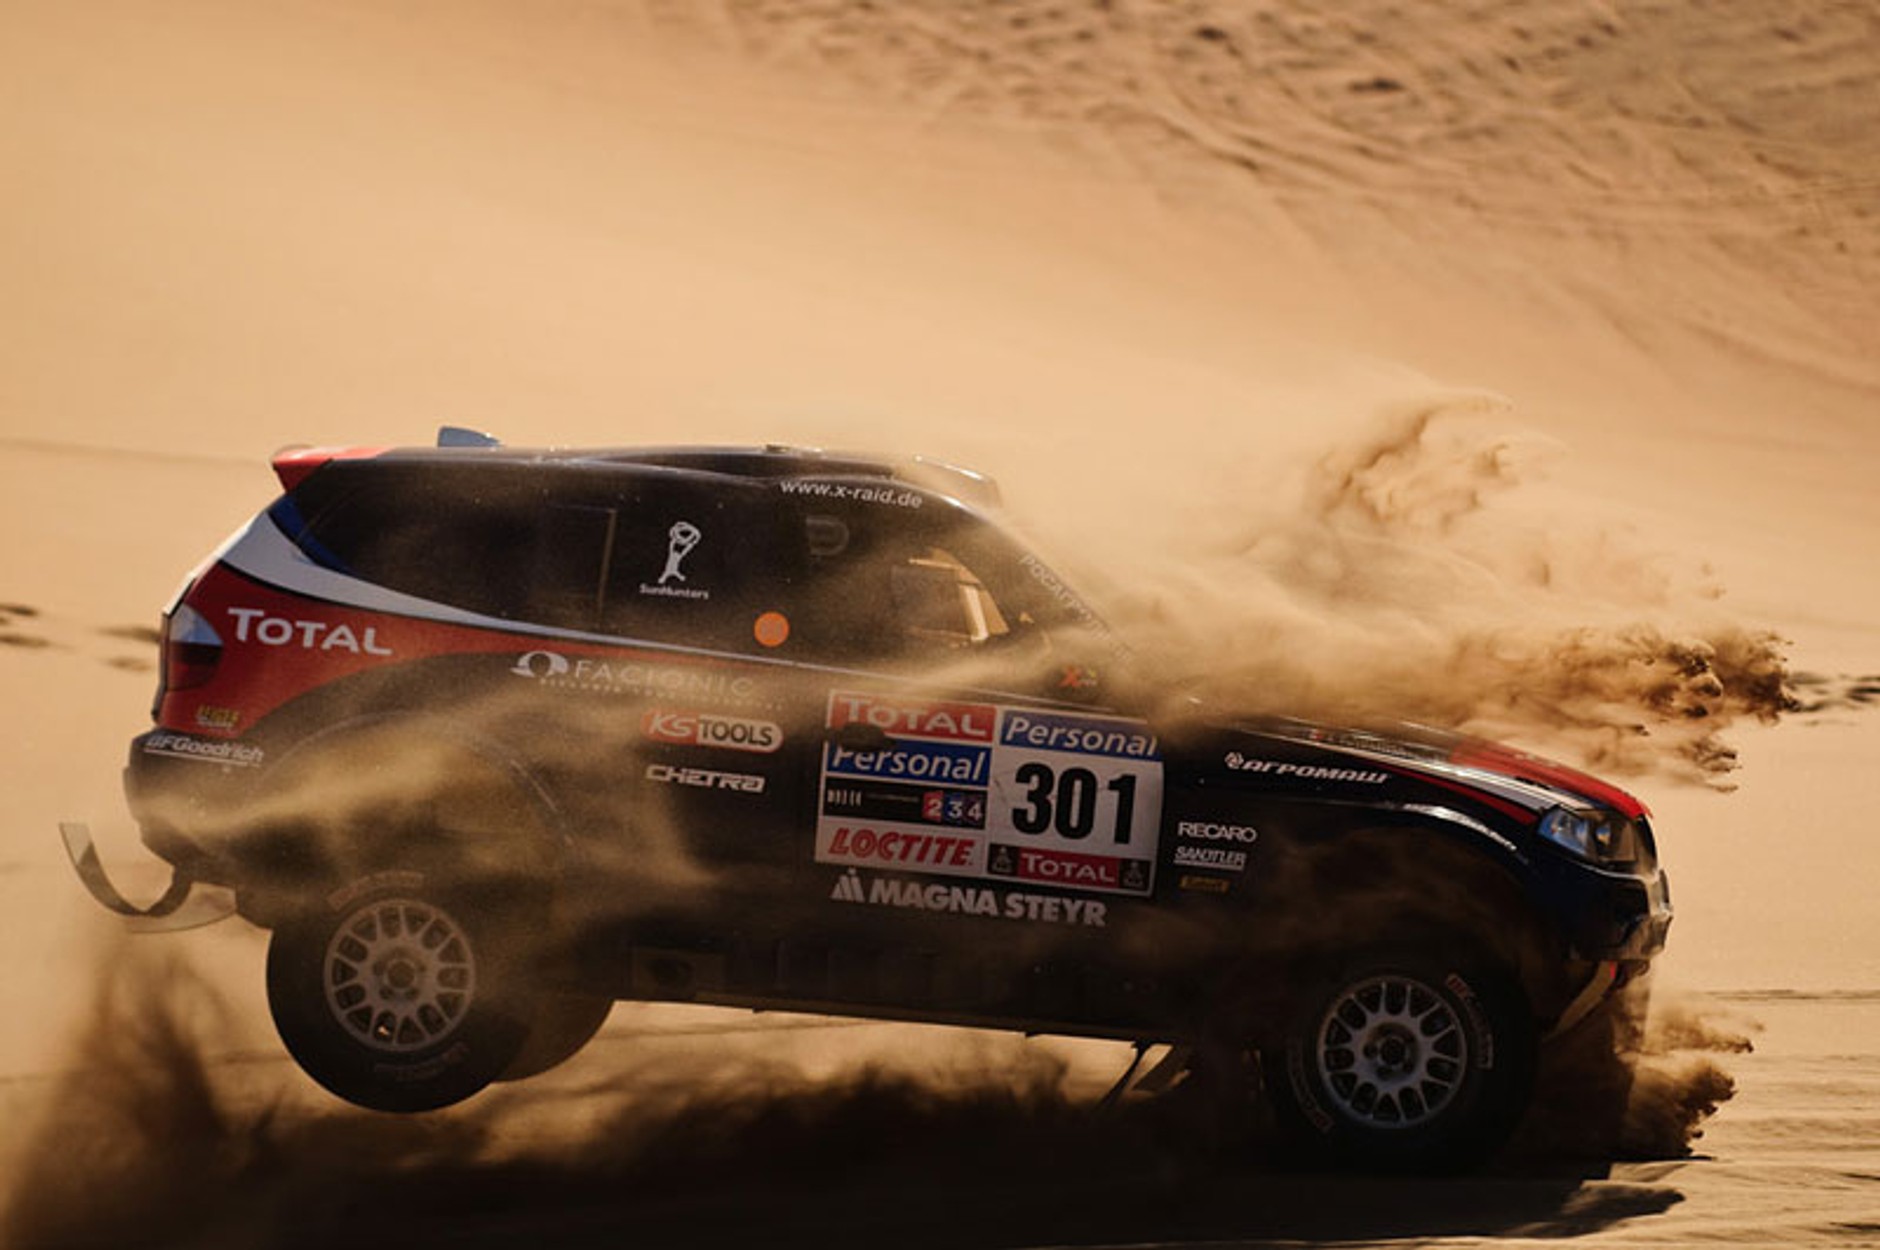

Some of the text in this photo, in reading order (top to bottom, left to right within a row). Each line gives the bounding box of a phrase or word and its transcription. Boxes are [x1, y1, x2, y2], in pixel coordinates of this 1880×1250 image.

[780, 480, 922, 508] www.x-raid.de
[648, 713, 774, 747] KS TOOLS
[1005, 716, 1157, 757] Personal
[1010, 762, 1138, 845] 301
[829, 827, 975, 866] LOCTITE
[1177, 821, 1257, 843] RECARO
[1021, 852, 1116, 883] TOTAL
[869, 878, 1107, 927] MAGNA STEYR
